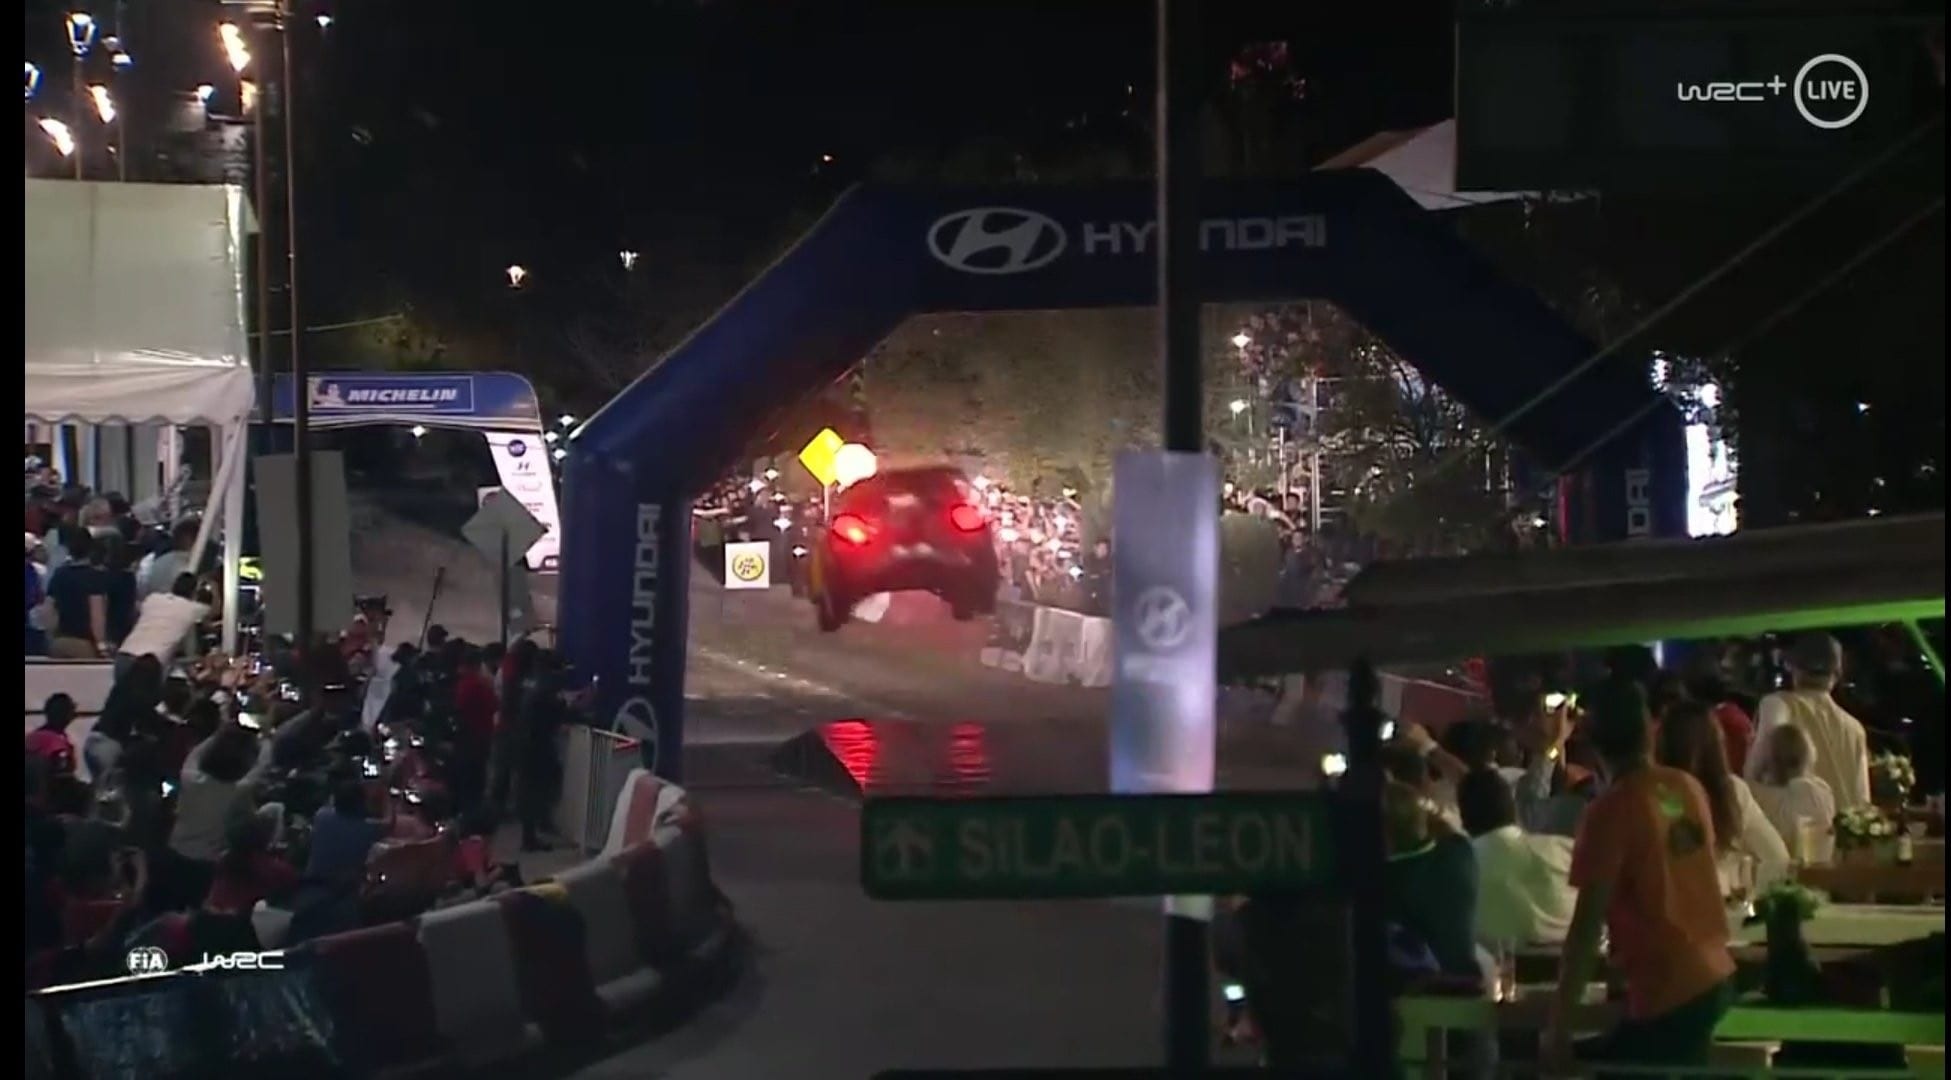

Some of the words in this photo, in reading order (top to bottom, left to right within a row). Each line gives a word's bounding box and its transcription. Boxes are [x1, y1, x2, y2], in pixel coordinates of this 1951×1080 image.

[1083, 214, 1327, 254] HYNDAI
[348, 389, 458, 402] MICHELIN
[628, 503, 662, 684] HYUNDAI
[956, 811, 1312, 878] SILAO-LEON
